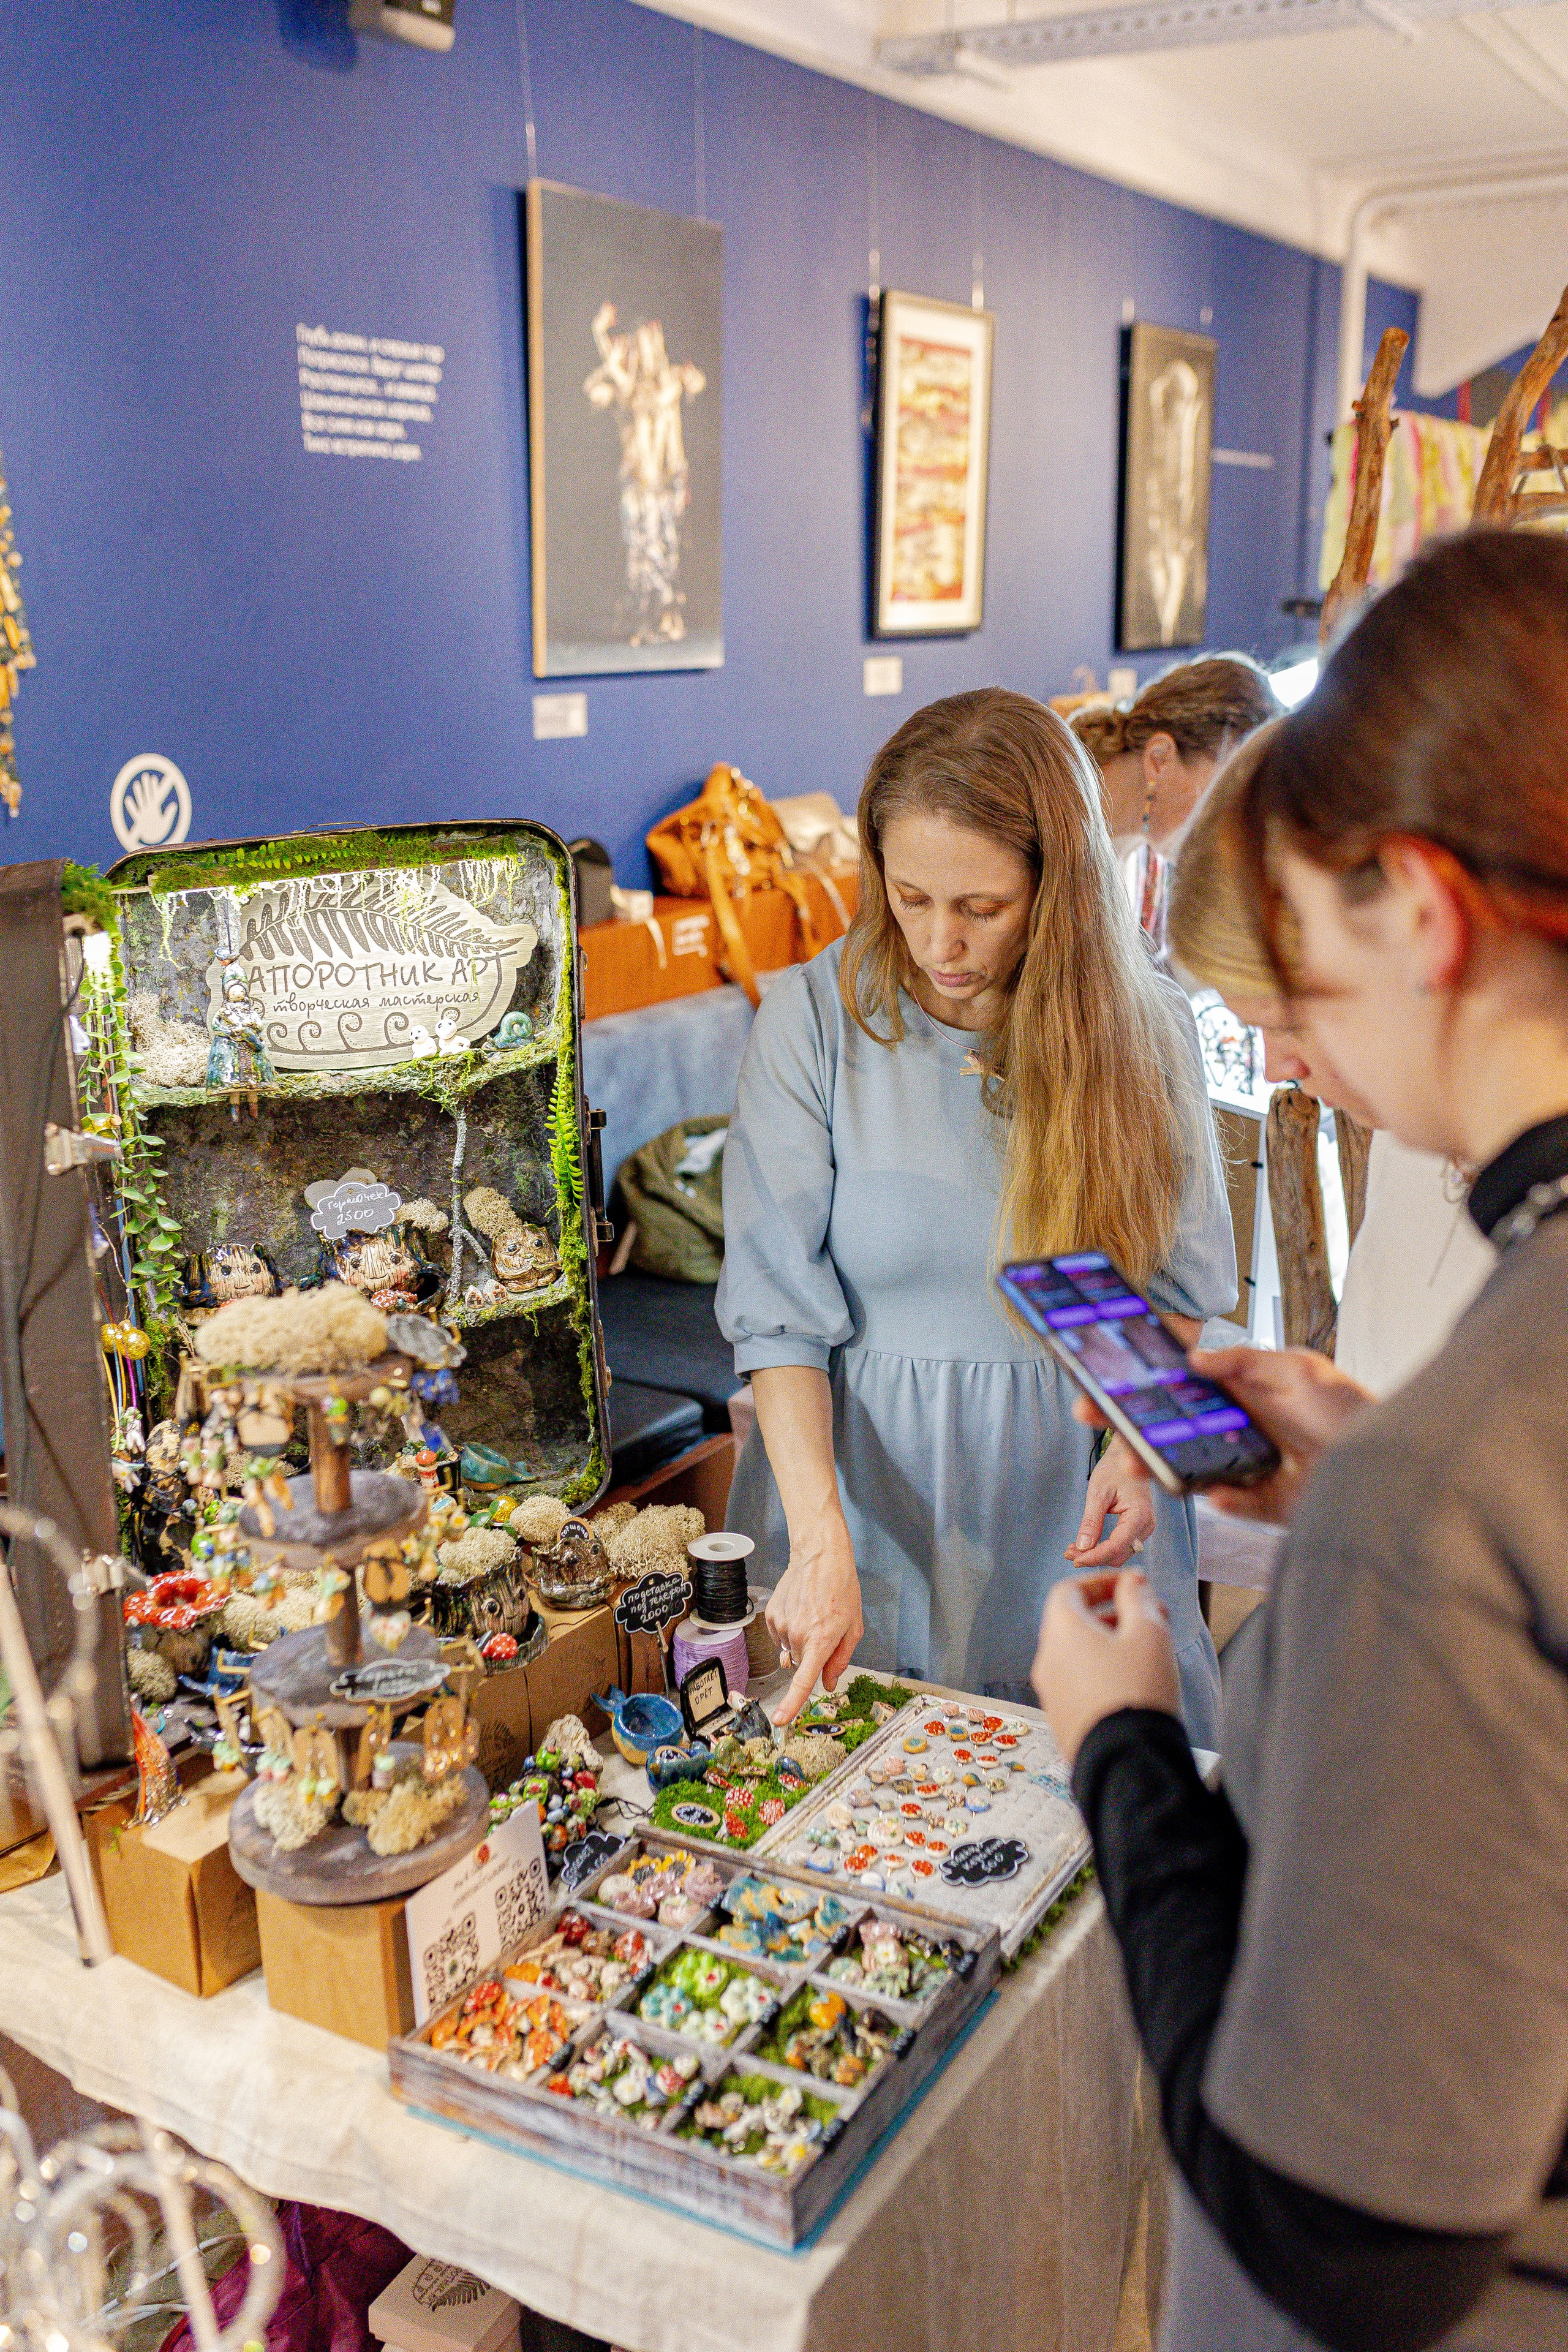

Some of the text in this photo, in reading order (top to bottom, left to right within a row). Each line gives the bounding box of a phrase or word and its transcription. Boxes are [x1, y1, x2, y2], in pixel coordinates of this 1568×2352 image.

[247, 951, 518, 995] АПОРОТНИК АРТ
[273, 992, 479, 1019] творческая мастерская
[628, 1577, 681, 1604] подставка
[630, 1584, 687, 1614] под телефон
[640, 1605, 668, 1623] 2000
[689, 1670, 718, 1695] РАБОТАЕТ
